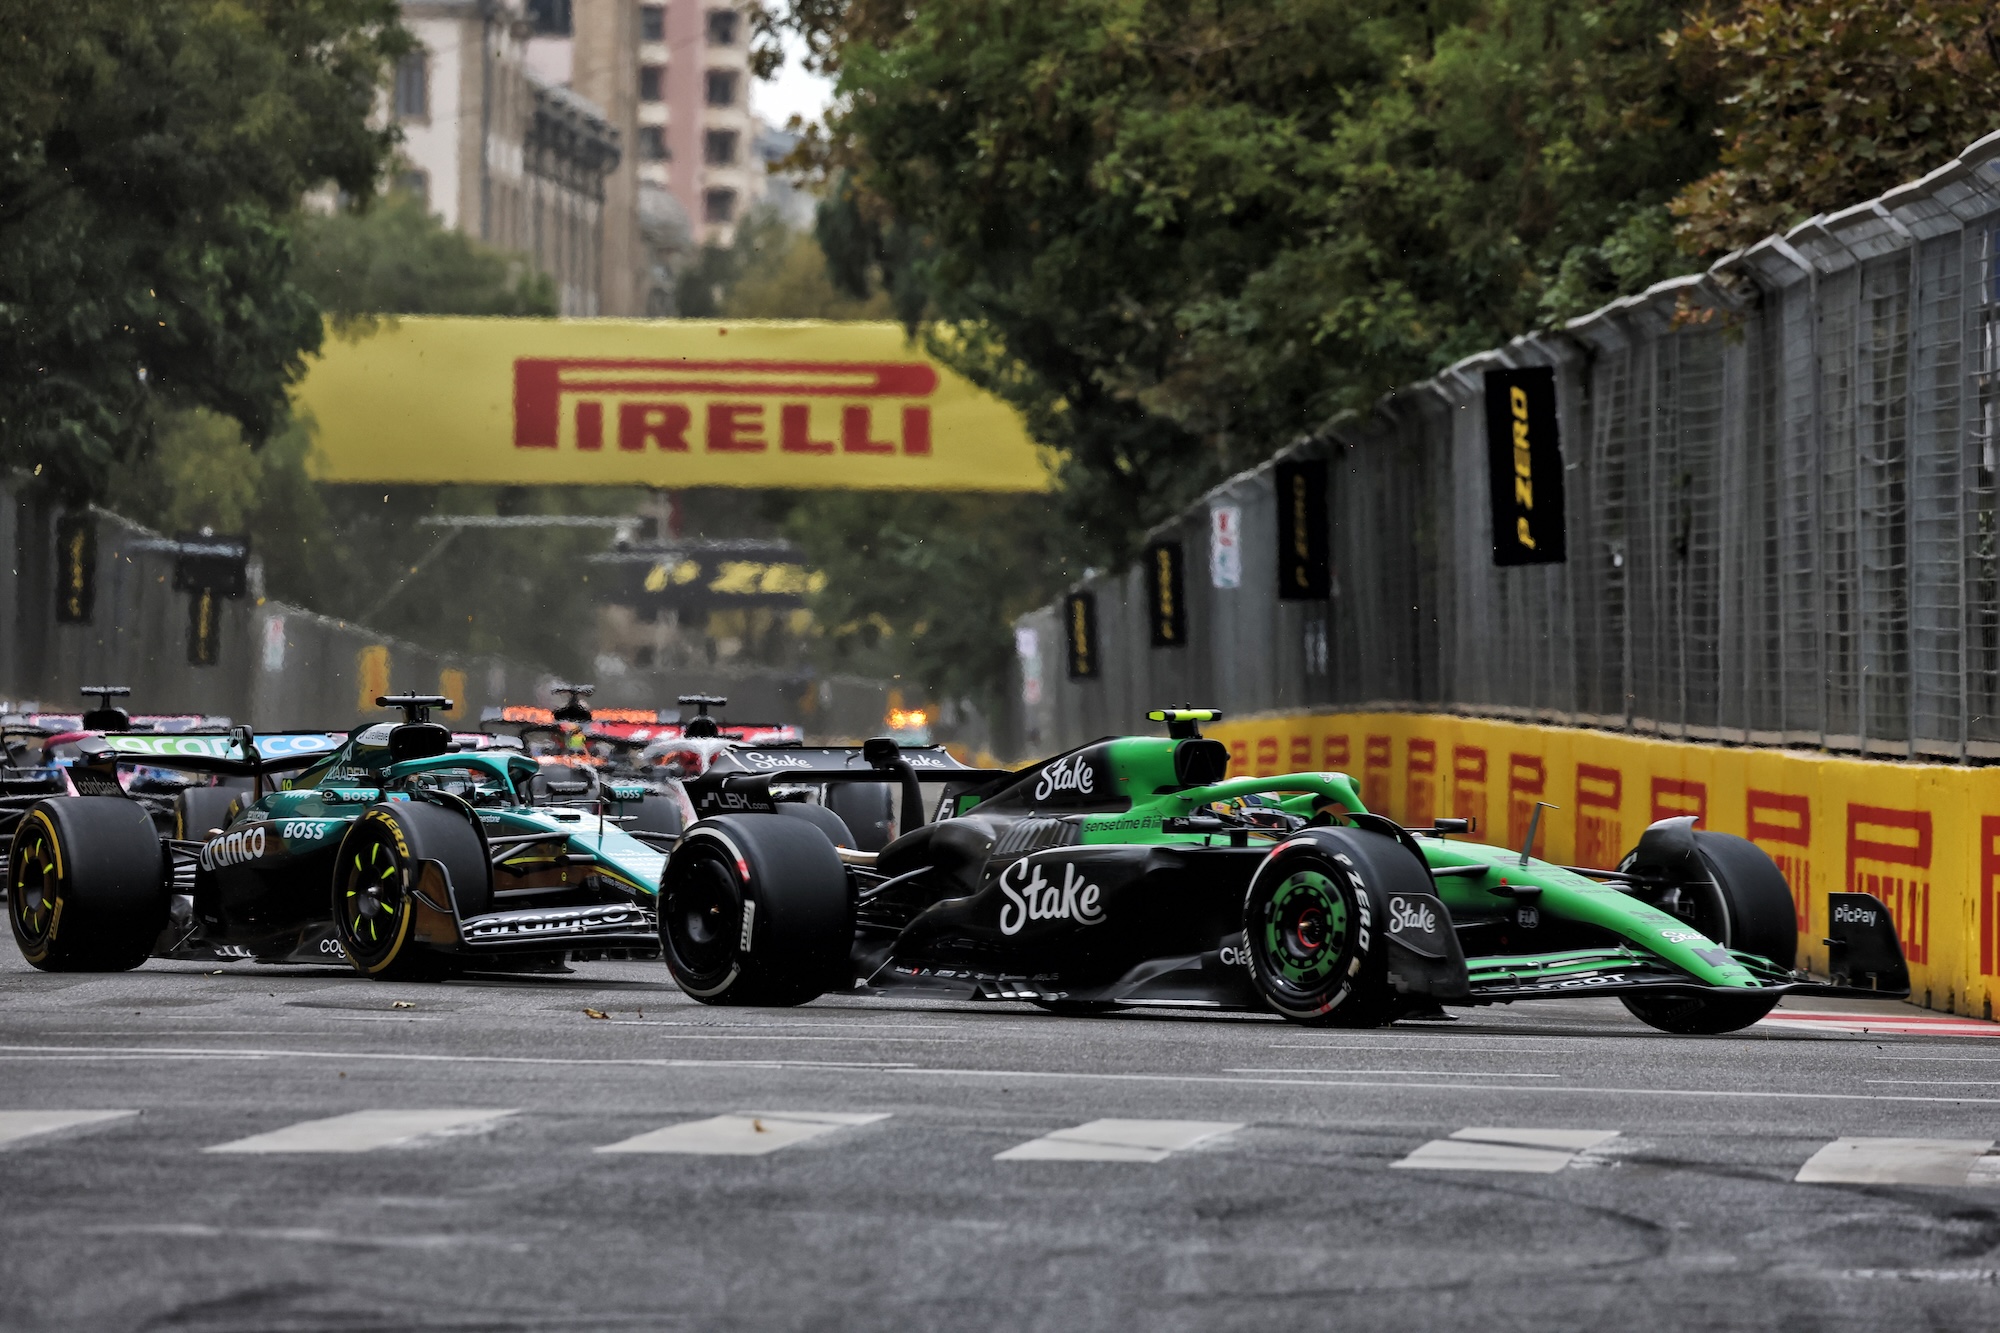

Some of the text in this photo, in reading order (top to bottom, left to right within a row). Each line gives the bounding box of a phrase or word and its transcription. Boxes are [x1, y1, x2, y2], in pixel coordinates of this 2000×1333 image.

[512, 357, 939, 455] PIRELLI
[1509, 385, 1534, 511] ZERO
[746, 751, 814, 769] Stake
[77, 777, 121, 796] coinbase
[282, 779, 293, 791] 10
[615, 789, 640, 799] BOSS
[1035, 756, 1094, 801] Stake
[342, 791, 376, 801] BOSS
[283, 822, 326, 841] BOSS
[376, 812, 411, 858] ZERO
[1083, 818, 1140, 833] sensetime
[200, 826, 266, 872] aramco
[1000, 856, 1107, 936] Stake
[1346, 870, 1372, 952] ZERO
[473, 905, 629, 937] aramco
[1389, 896, 1436, 934] Stake
[1834, 904, 1878, 927] PicPay
